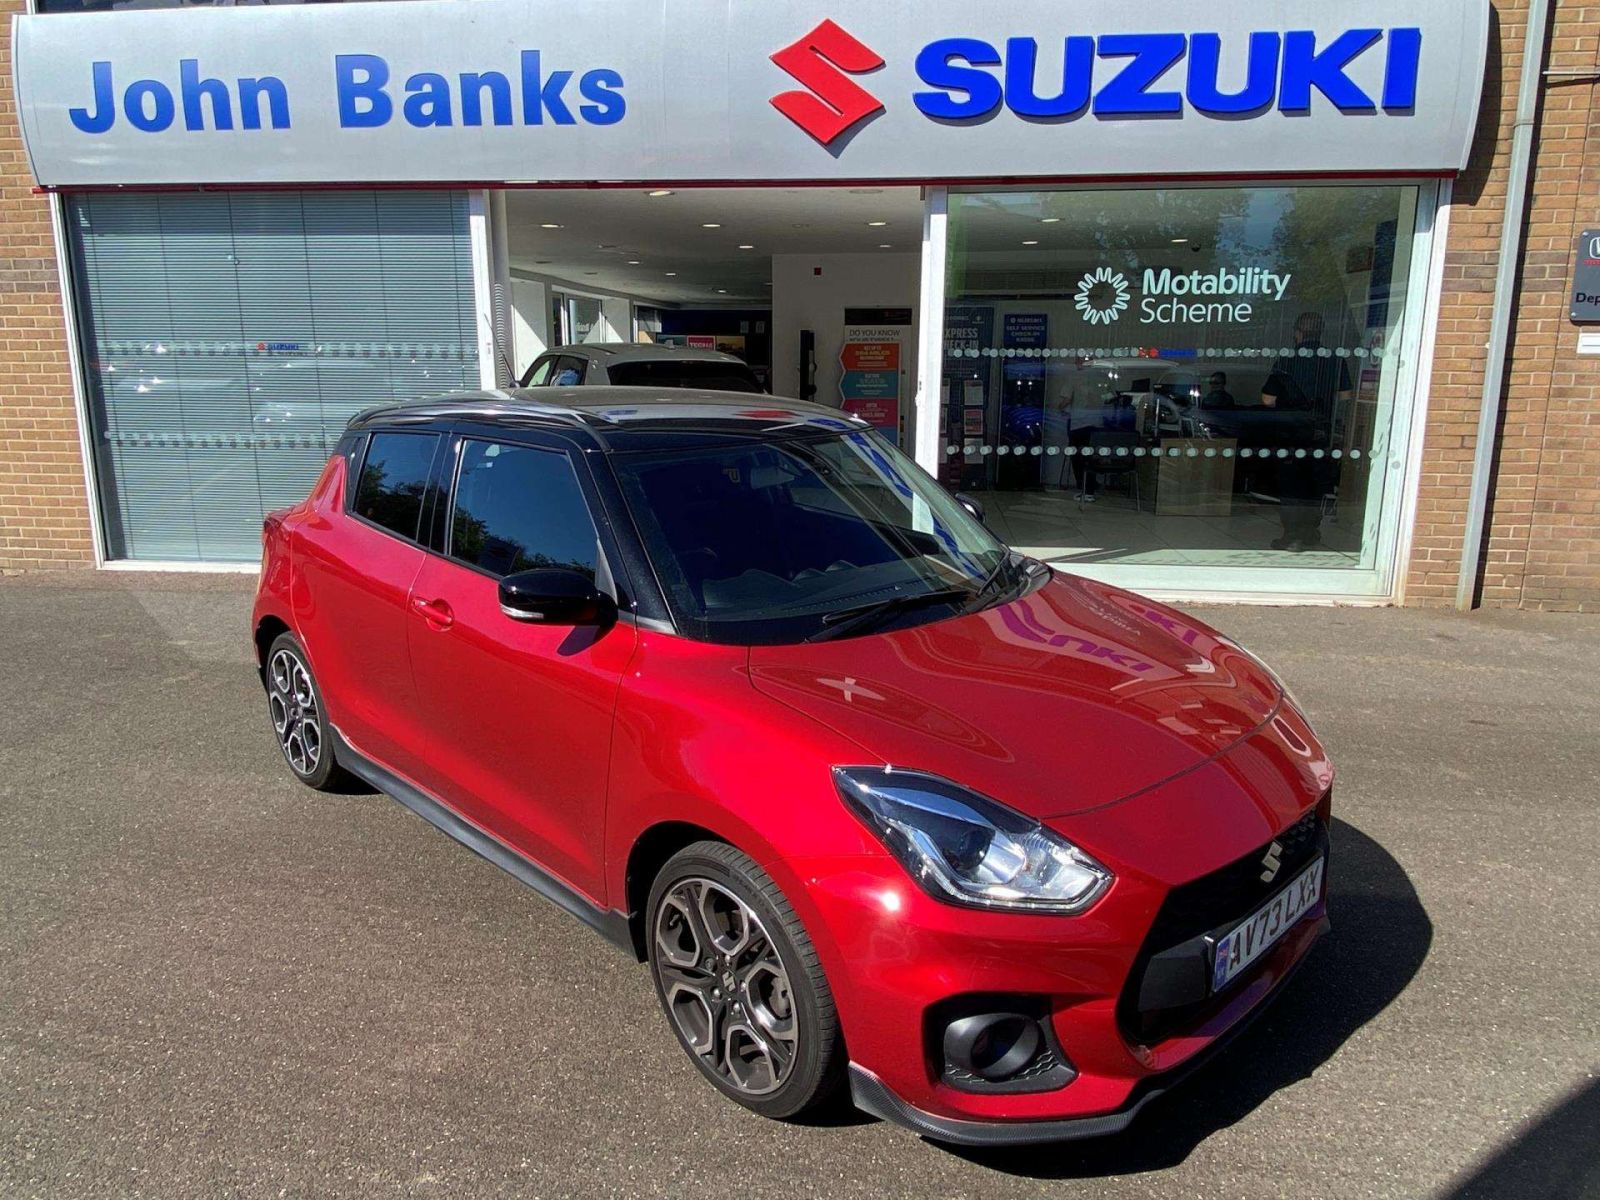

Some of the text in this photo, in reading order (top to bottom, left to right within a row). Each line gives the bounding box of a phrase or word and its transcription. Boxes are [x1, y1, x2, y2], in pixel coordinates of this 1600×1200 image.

[912, 27, 1422, 120] SUZUKI
[69, 49, 627, 134] John Banks
[1142, 267, 1291, 300] Motability
[1140, 298, 1252, 323] Scheme
[877, 328, 900, 336] KNOW
[944, 328, 978, 339] XPRESS
[944, 339, 979, 350] HECK-IN
